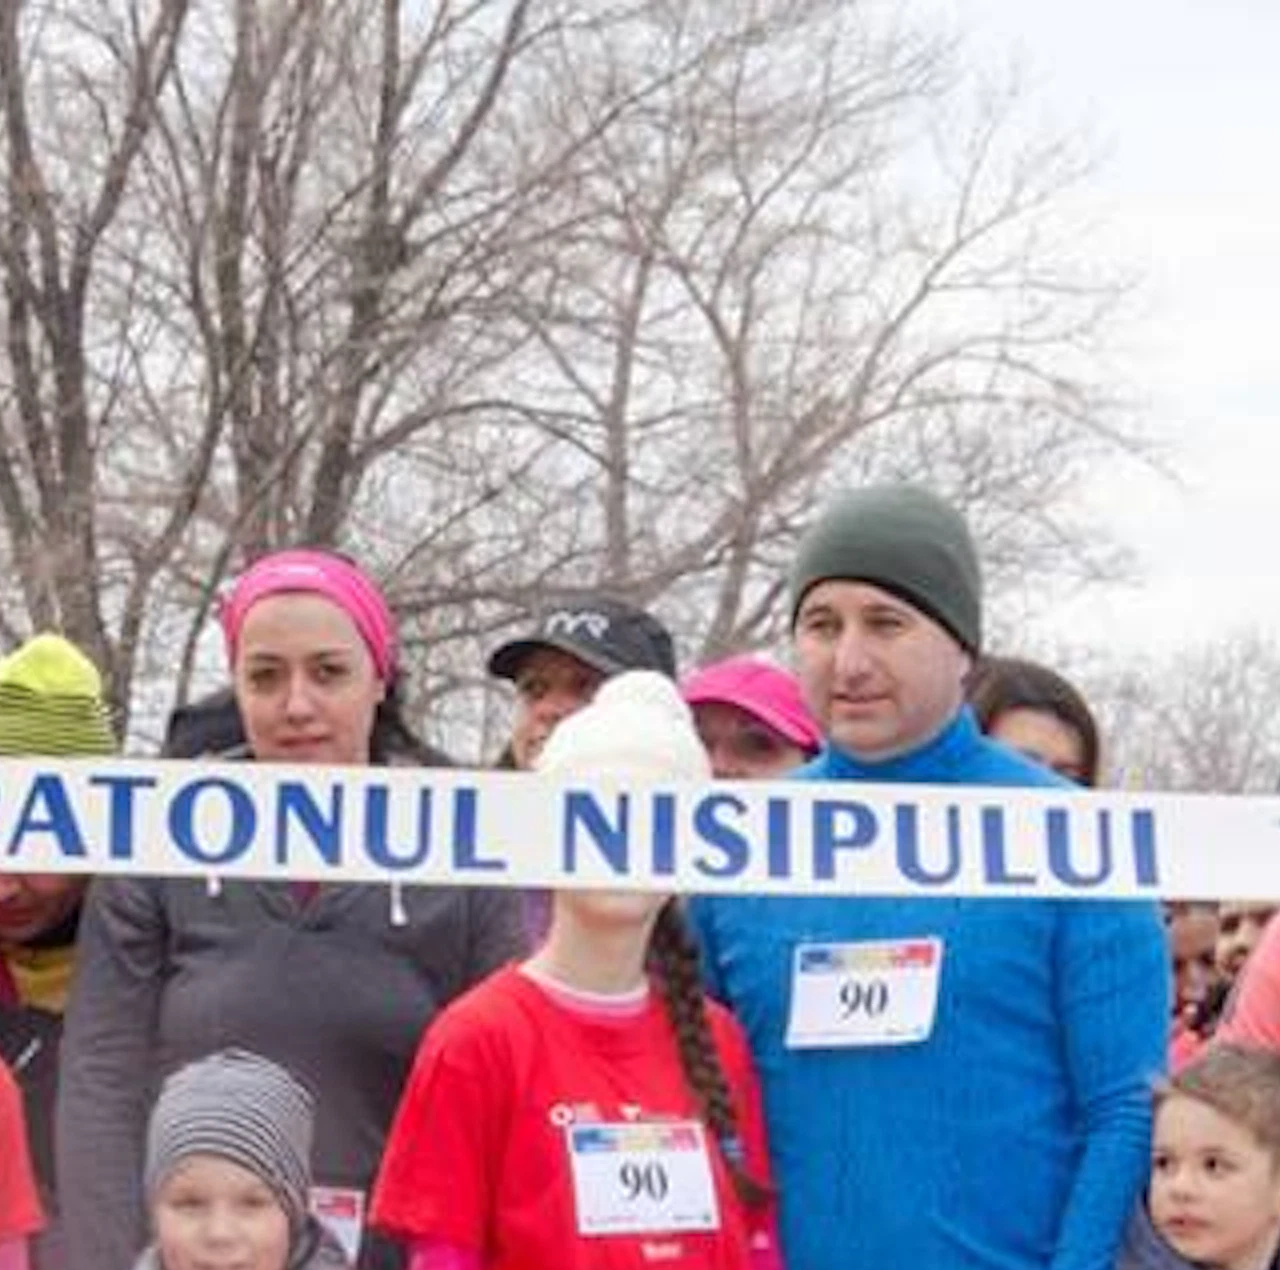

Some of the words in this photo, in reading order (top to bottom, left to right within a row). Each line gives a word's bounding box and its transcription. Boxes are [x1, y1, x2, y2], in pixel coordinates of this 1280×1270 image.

[563, 790, 1160, 888] NISIPULUI
[840, 977, 888, 1020] 90
[620, 1160, 669, 1201] 90
